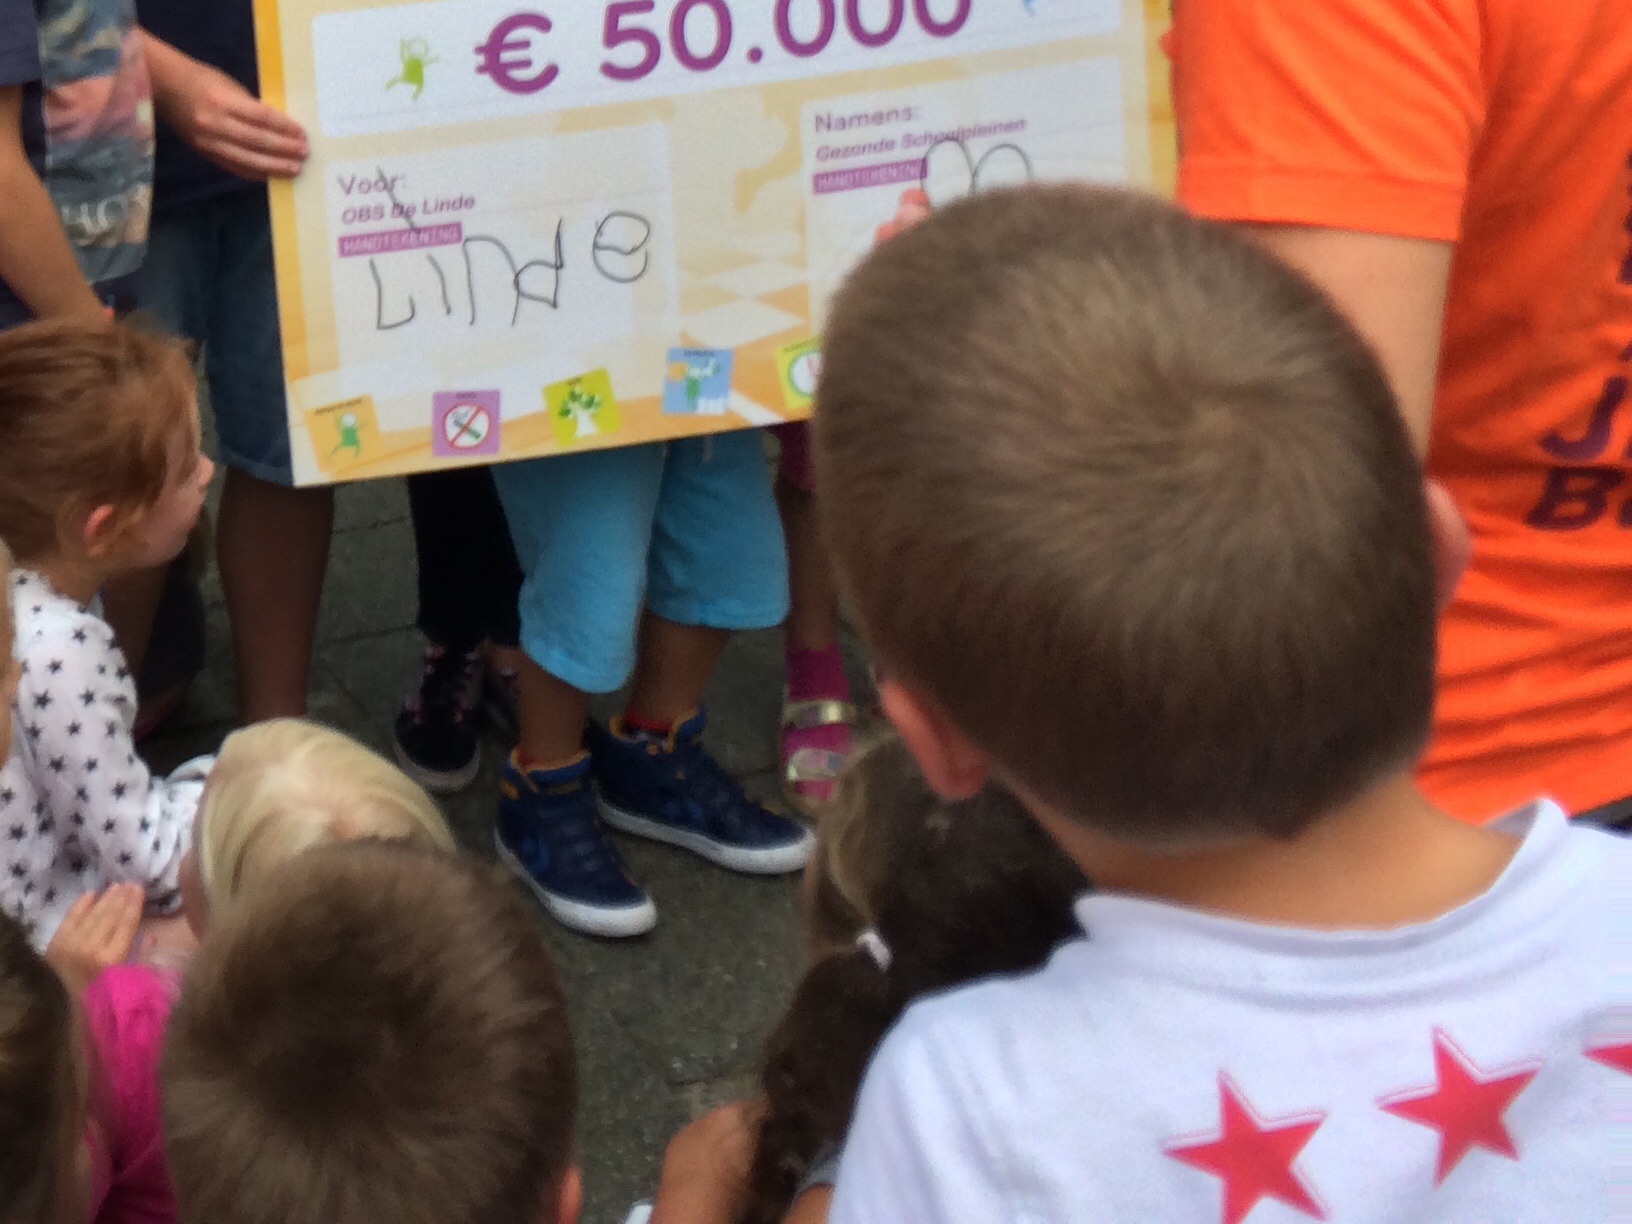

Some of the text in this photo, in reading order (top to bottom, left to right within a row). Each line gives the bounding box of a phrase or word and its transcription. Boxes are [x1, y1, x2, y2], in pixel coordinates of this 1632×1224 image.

[473, 12, 560, 95] €
[815, 137, 897, 163] Gezonde
[340, 205, 386, 226] OBS
[422, 194, 476, 217] Linde
